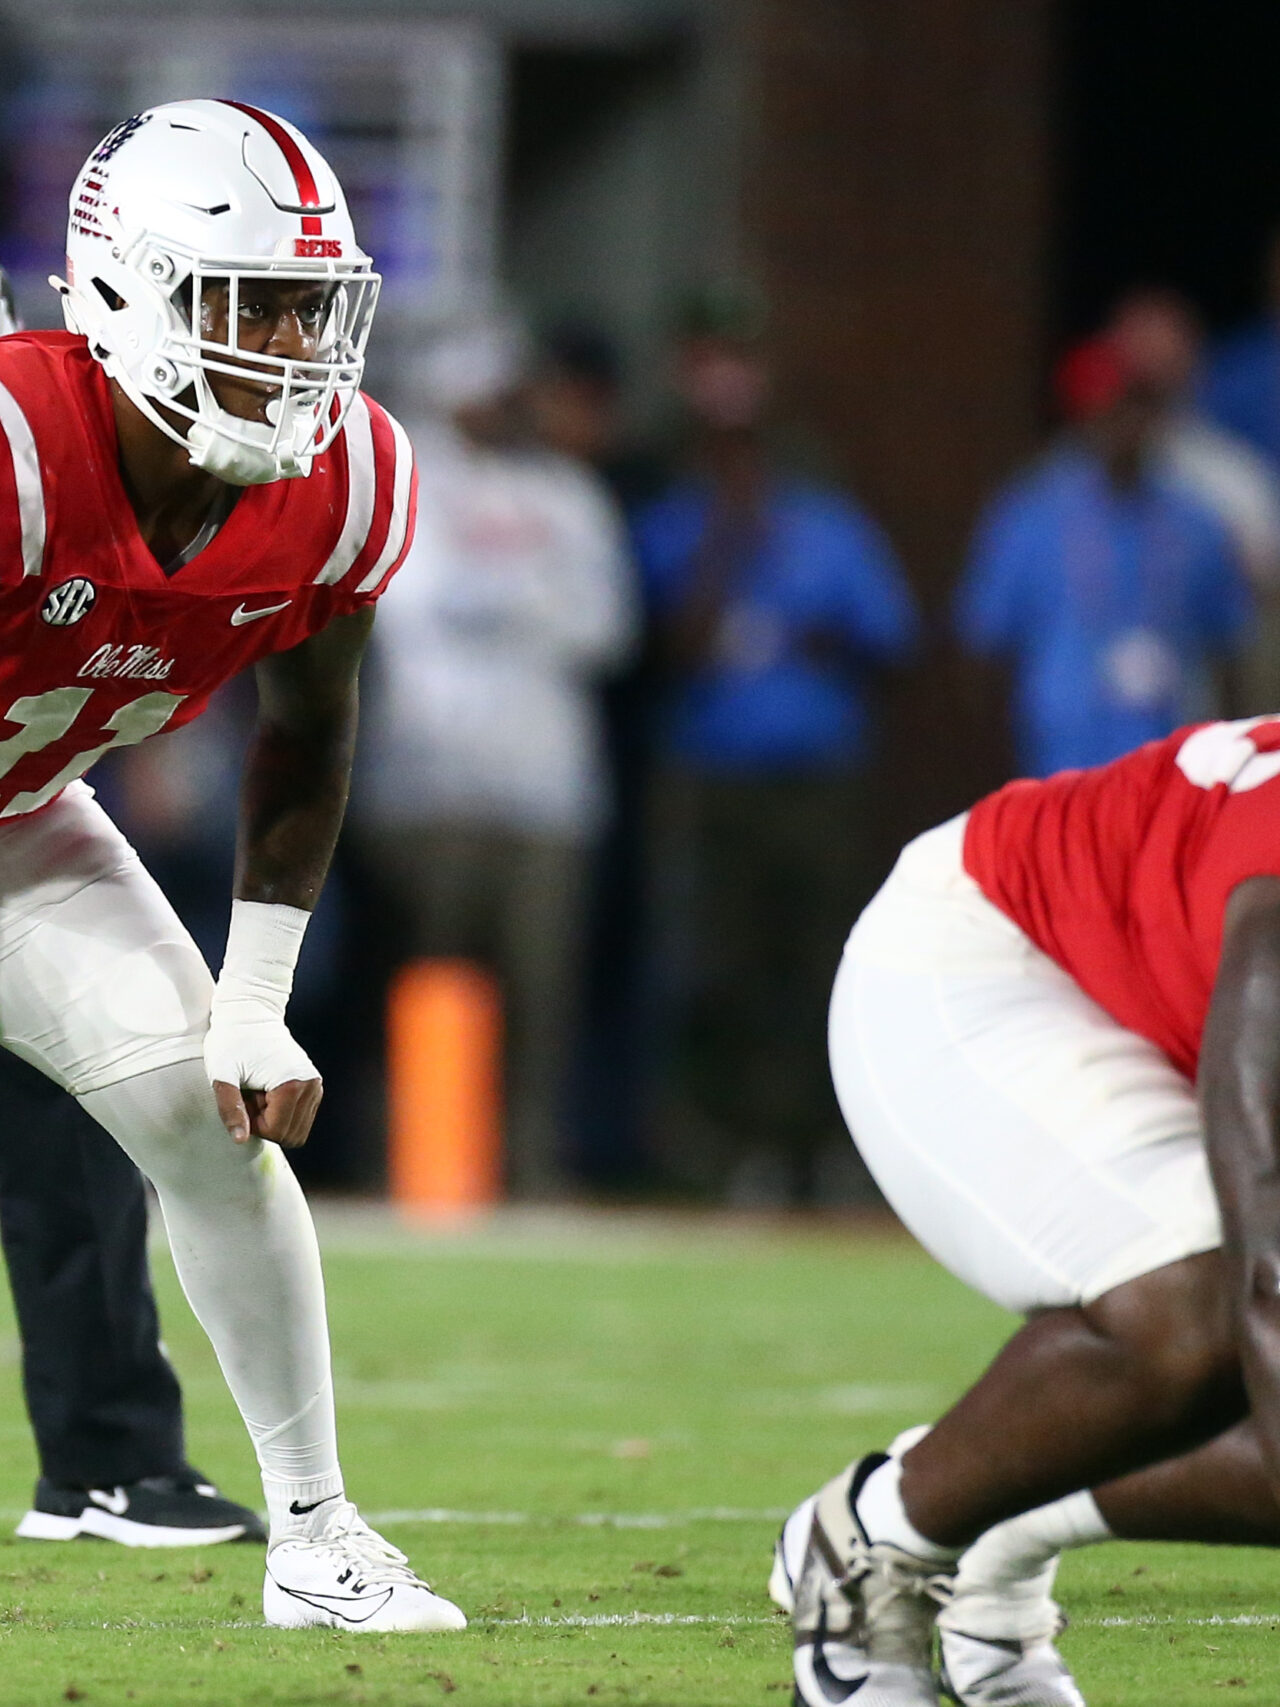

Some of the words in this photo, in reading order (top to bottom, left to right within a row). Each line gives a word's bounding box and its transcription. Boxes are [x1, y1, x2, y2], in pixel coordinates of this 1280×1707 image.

[293, 238, 343, 258] REBS
[41, 579, 95, 626] SEC
[76, 643, 124, 678] Ole
[113, 644, 175, 680] Miss
